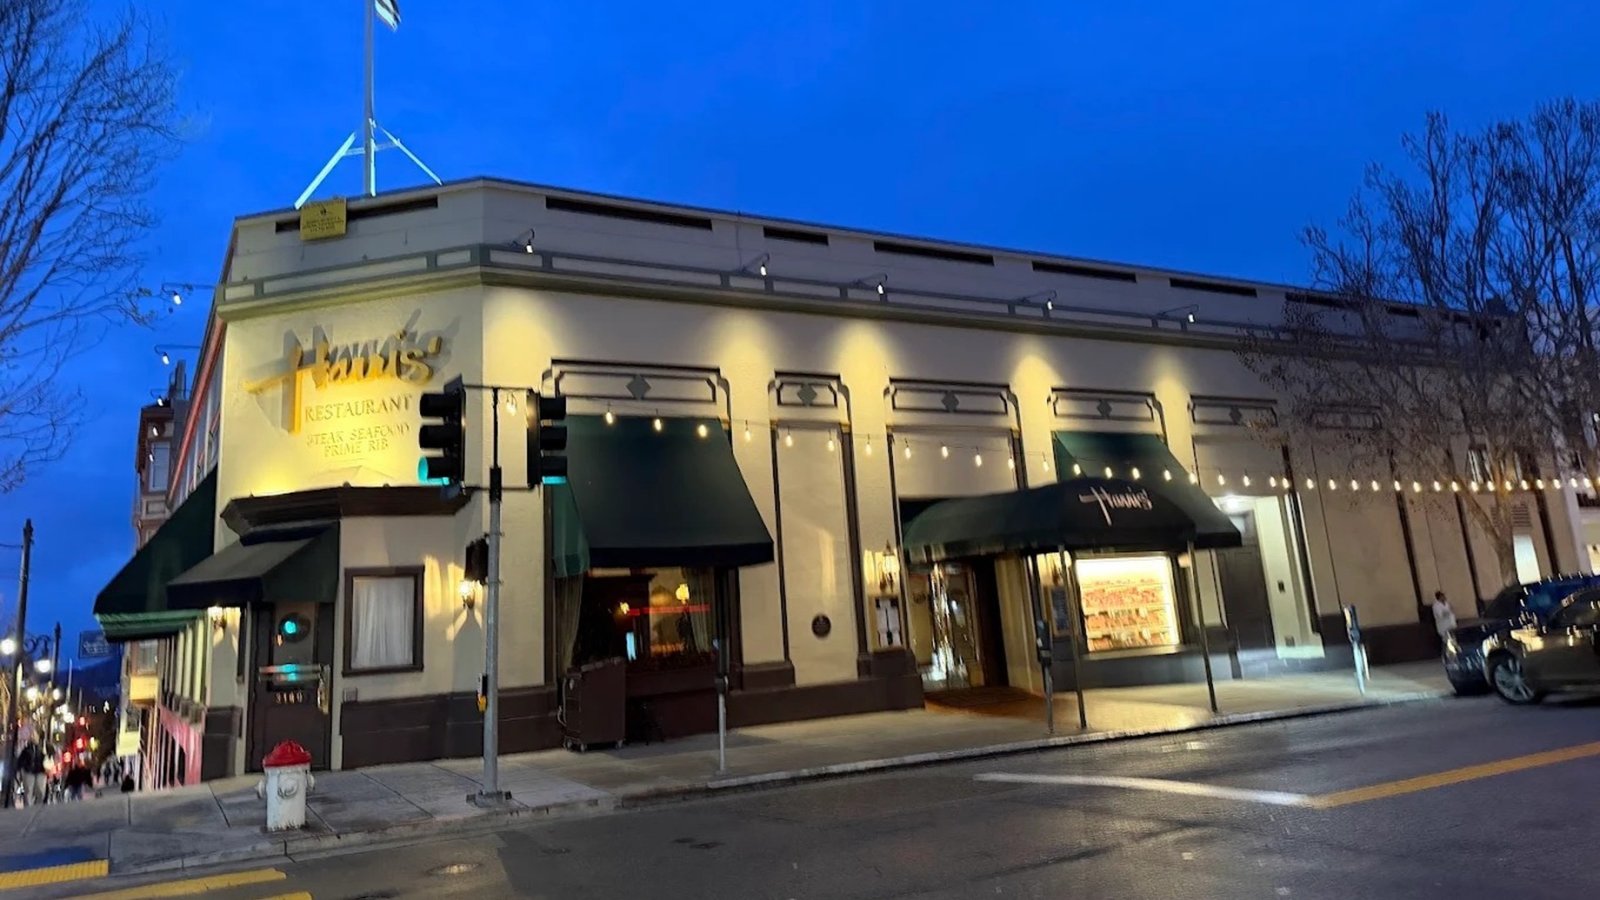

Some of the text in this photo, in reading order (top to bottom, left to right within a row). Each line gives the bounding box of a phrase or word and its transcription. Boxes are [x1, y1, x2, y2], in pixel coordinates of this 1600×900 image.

[304, 393, 413, 422] RESTAURANT
[306, 422, 410, 447] STEAK SEAFOOD
[324, 438, 389, 457] PRIME RIB
